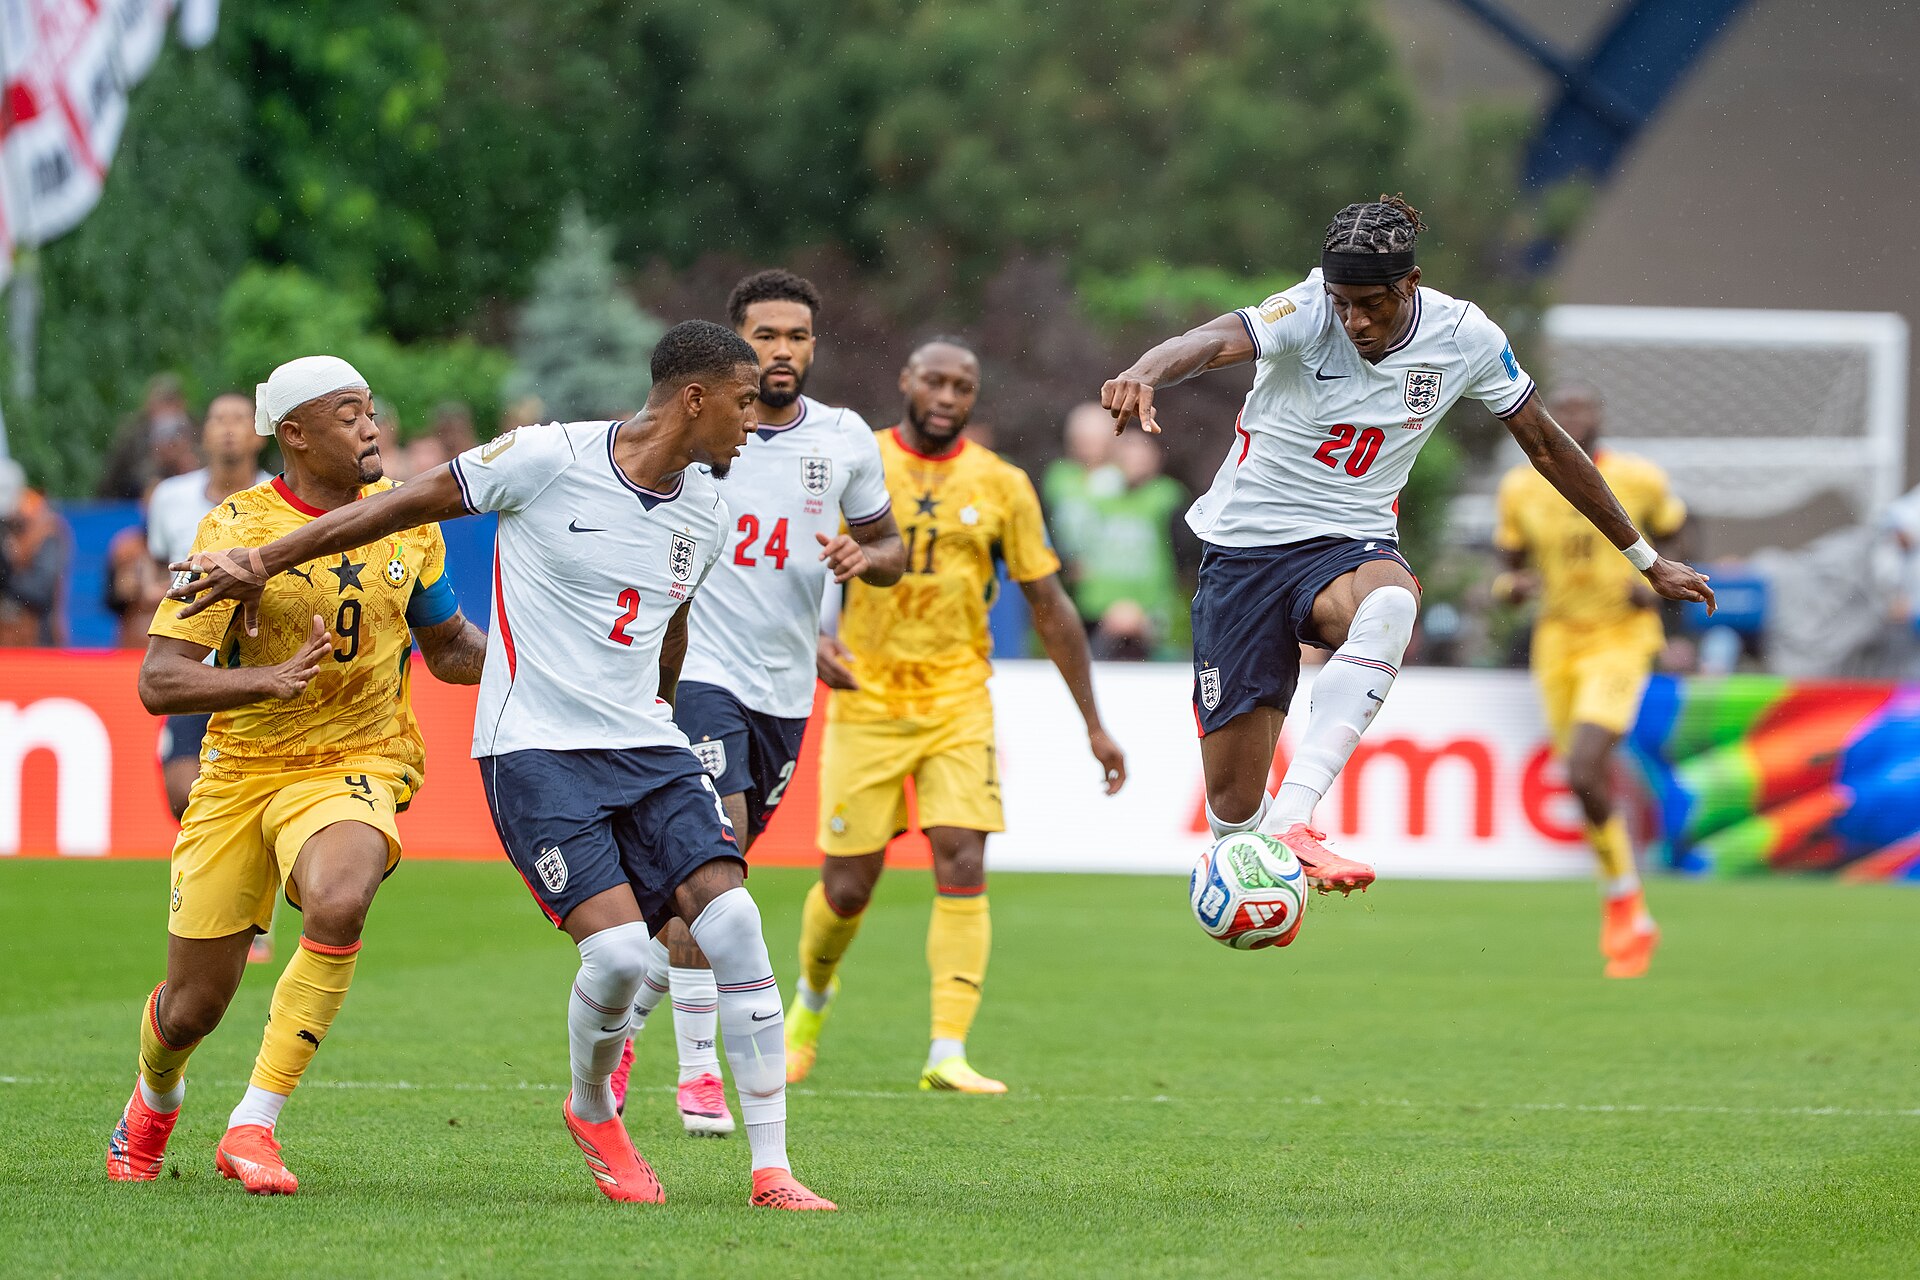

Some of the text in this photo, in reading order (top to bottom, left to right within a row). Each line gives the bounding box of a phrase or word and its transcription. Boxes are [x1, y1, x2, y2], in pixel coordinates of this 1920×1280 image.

[1313, 423, 1386, 478] 20
[734, 513, 789, 570] 24
[903, 525, 937, 574] 11
[333, 599, 362, 663] 9
[608, 587, 641, 647] 2
